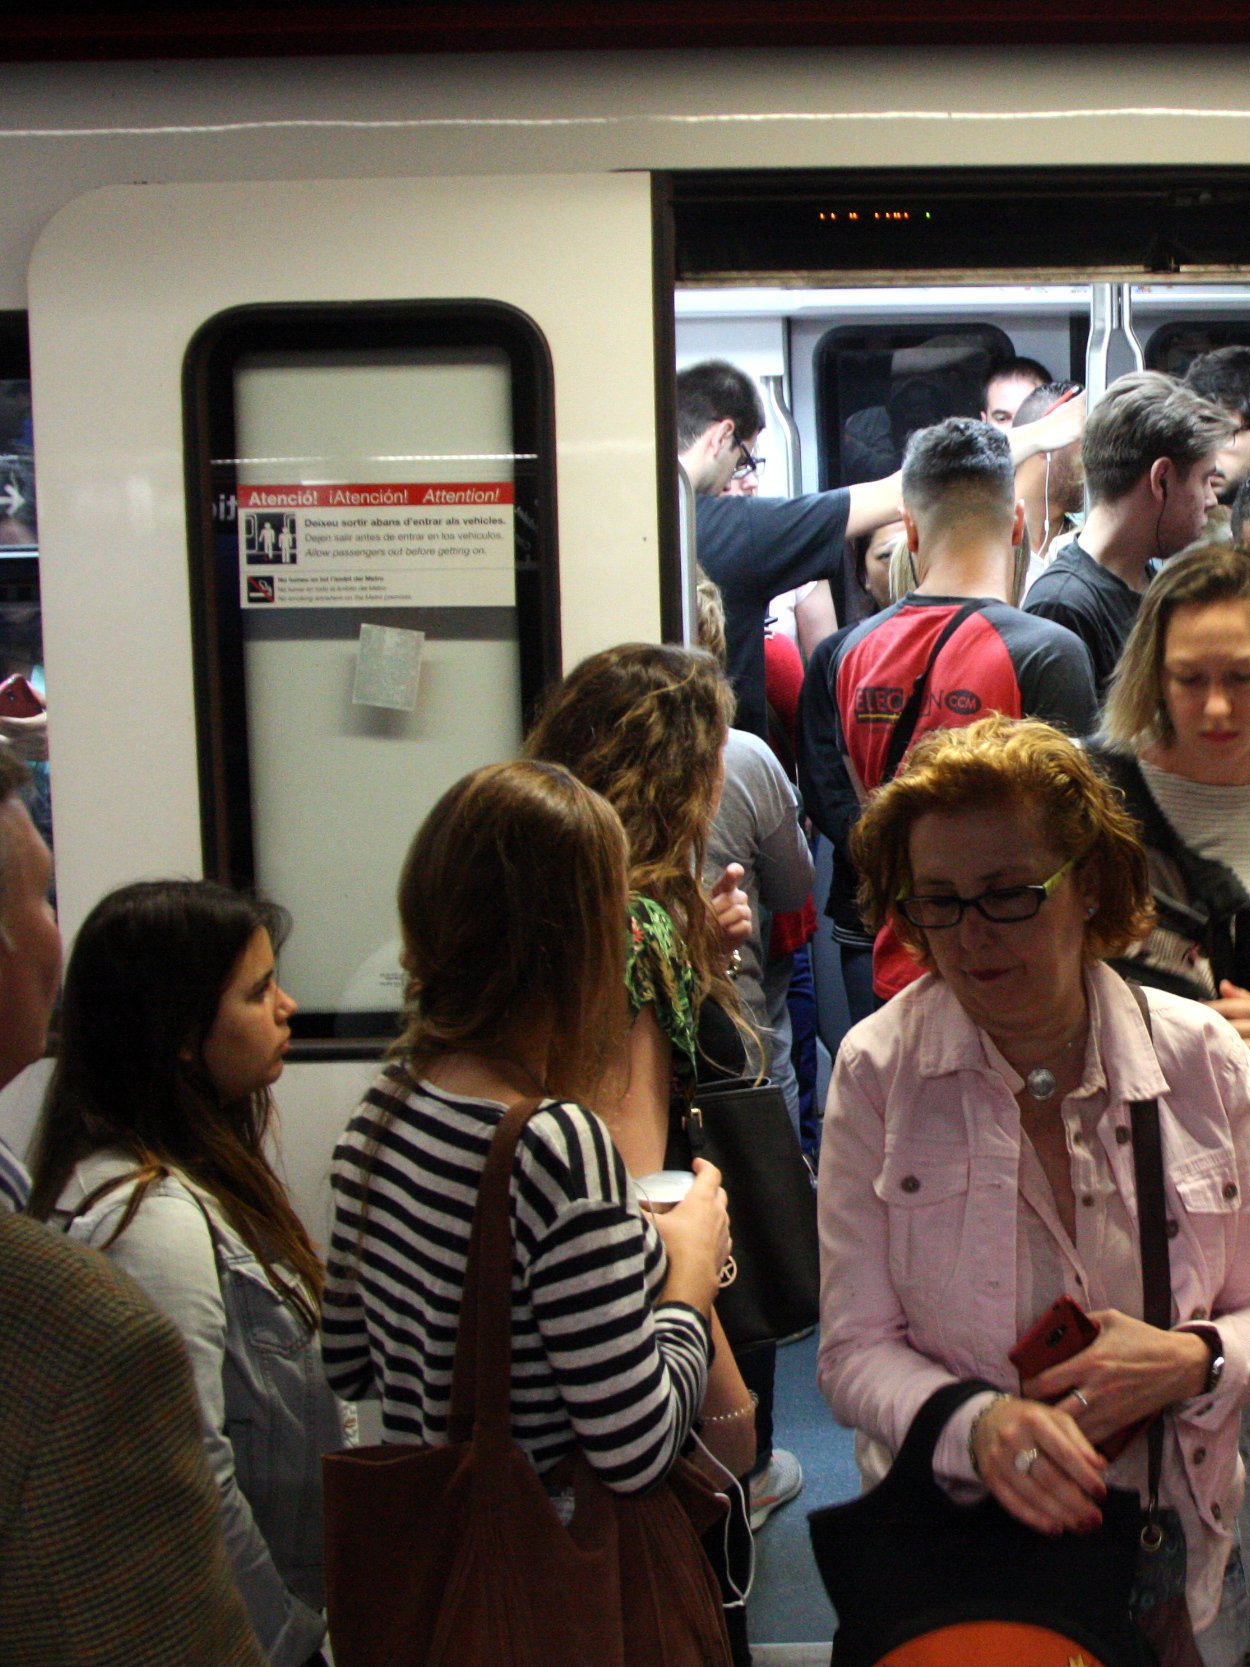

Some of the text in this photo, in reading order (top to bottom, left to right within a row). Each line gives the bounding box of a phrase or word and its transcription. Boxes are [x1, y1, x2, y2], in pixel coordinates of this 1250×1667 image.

[249, 487, 500, 506] Atenció! ¡Atención! Attention!
[304, 515, 507, 528] Deixeu sortir abans d'entrar als vehicles.
[383, 532, 396, 541] de
[397, 531, 425, 541] entrar
[427, 531, 440, 540] en
[441, 531, 456, 540] los
[332, 548, 385, 559] passengers
[387, 547, 404, 556] out
[405, 546, 436, 556] before
[950, 694, 976, 710] CCM
